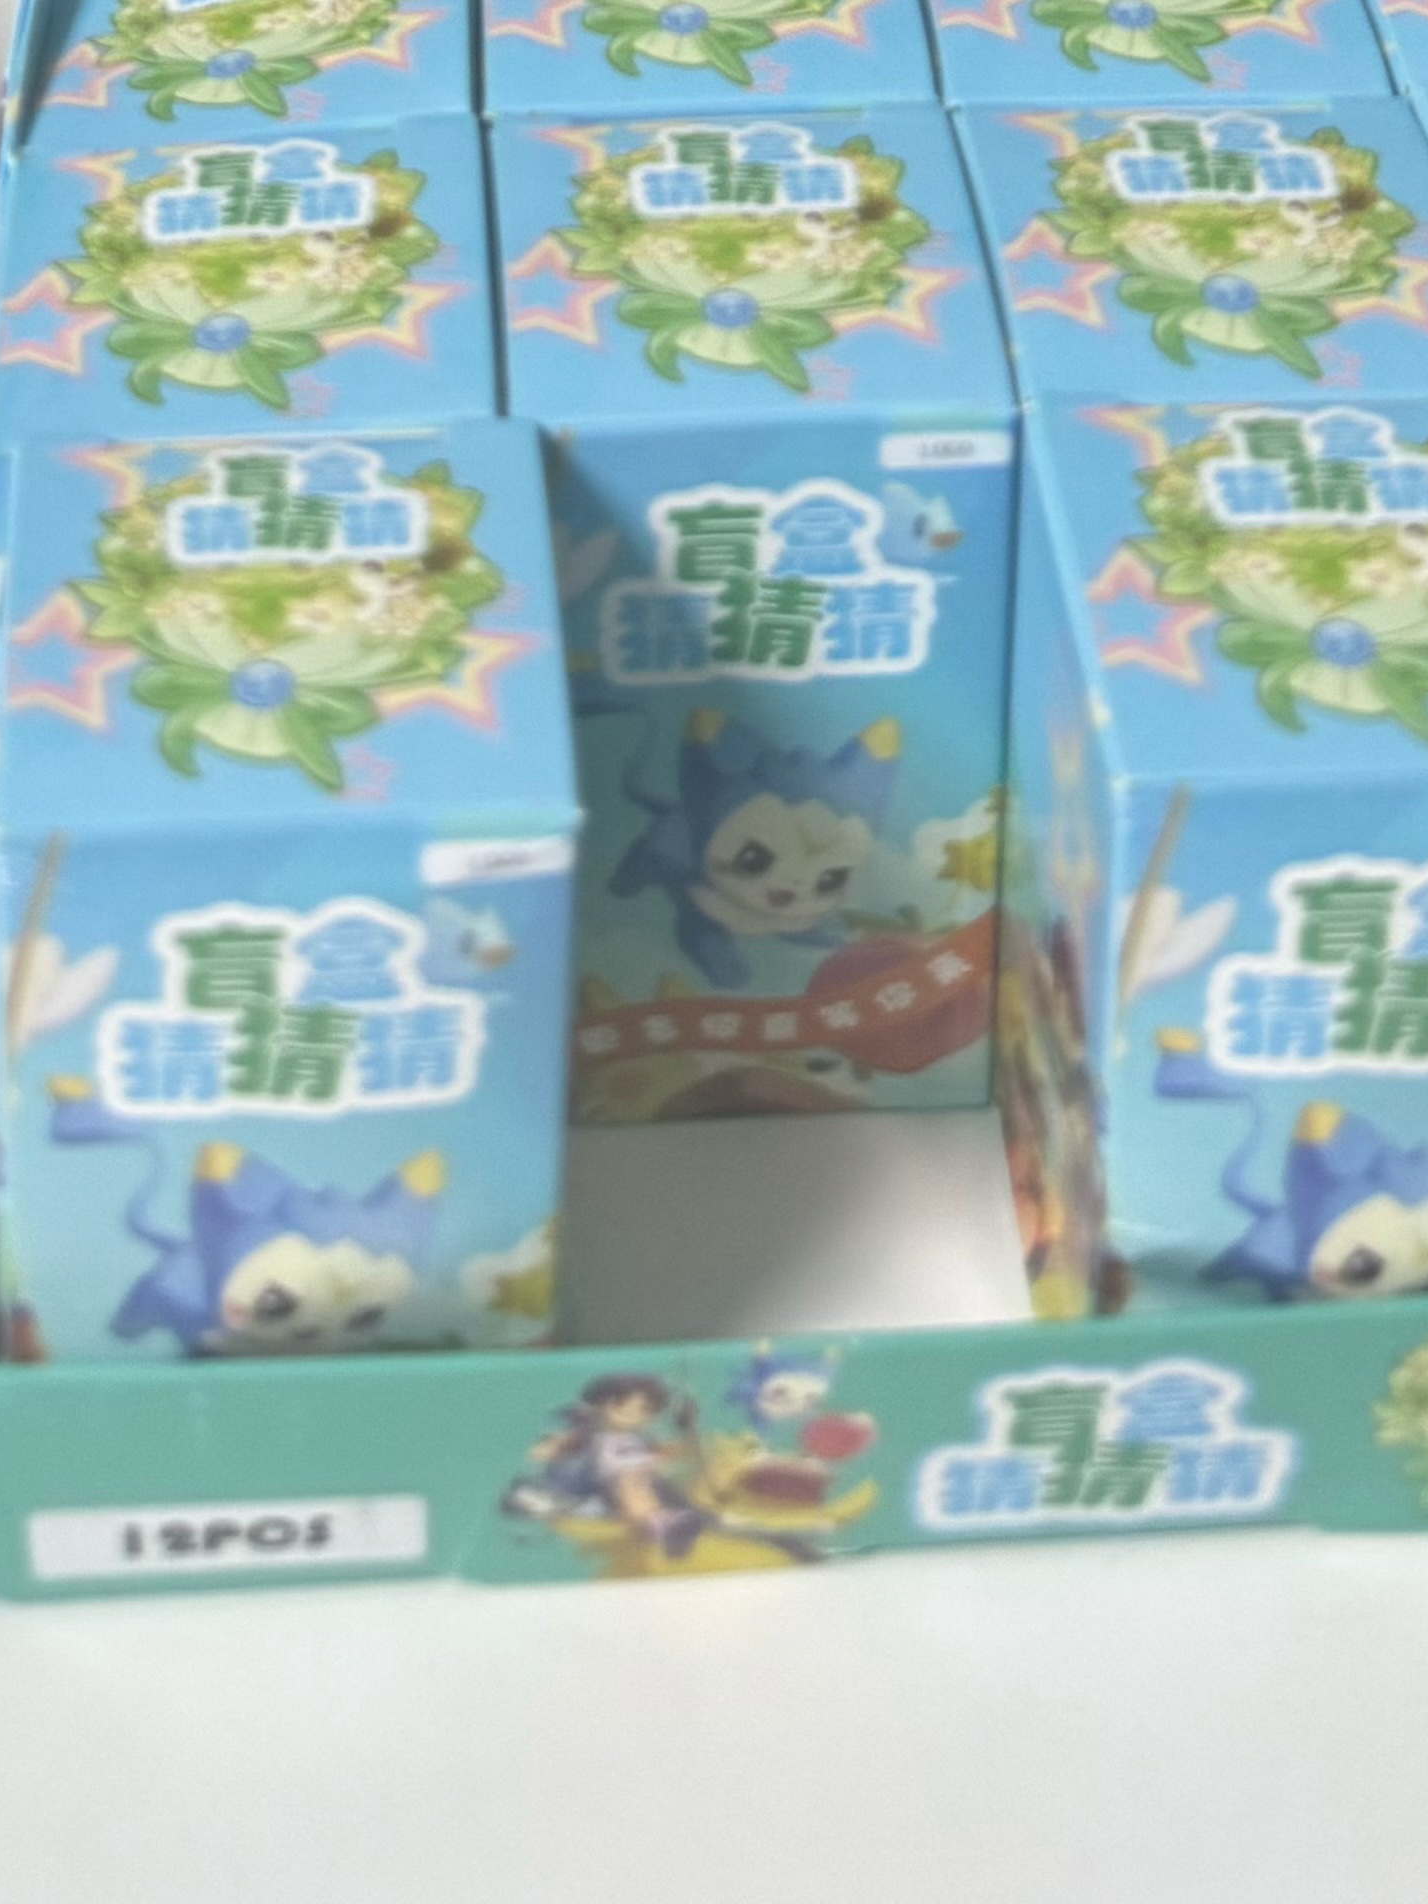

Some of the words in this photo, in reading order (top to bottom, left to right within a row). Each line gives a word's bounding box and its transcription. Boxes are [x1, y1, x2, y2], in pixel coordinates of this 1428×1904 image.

[668, 495, 868, 583] 盲盒
[619, 574, 917, 671] 猜猜猜
[176, 917, 405, 1012] 盲盒
[120, 1002, 465, 1101] 猜猜猜
